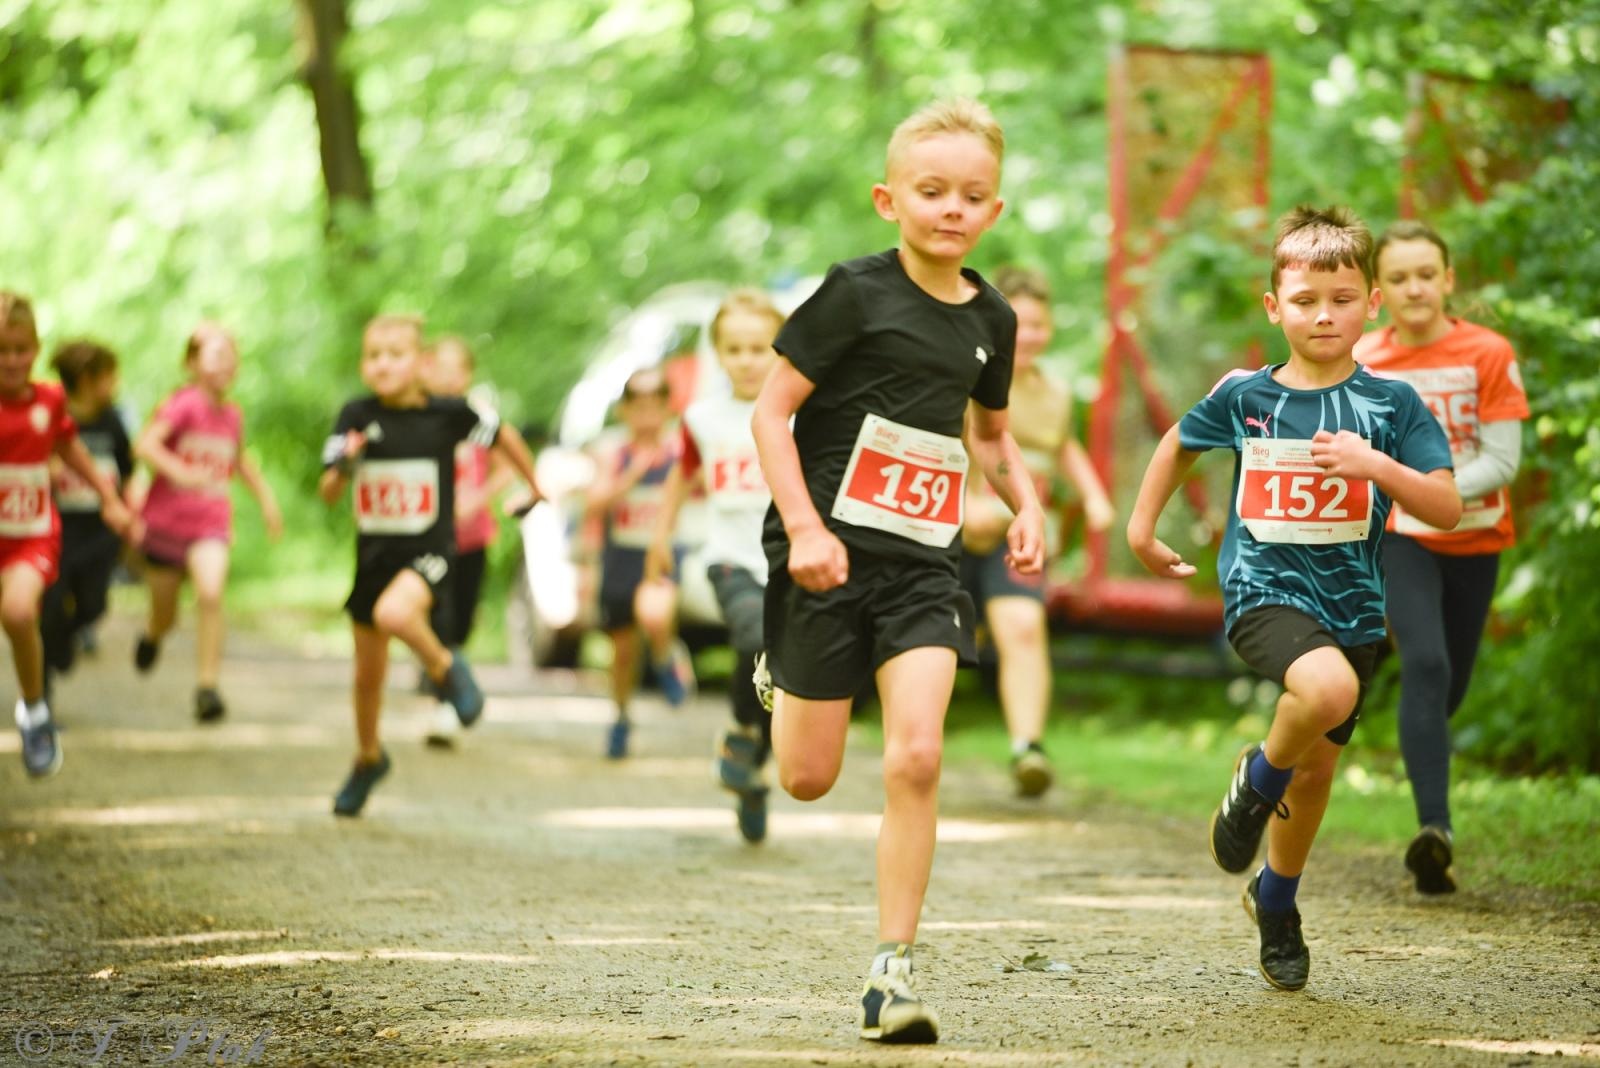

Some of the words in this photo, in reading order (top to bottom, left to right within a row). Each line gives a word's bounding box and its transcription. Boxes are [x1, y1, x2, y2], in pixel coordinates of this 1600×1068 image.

[1252, 446, 1270, 458] Bieg
[872, 463, 950, 519] 159
[1263, 475, 1348, 518] 152
